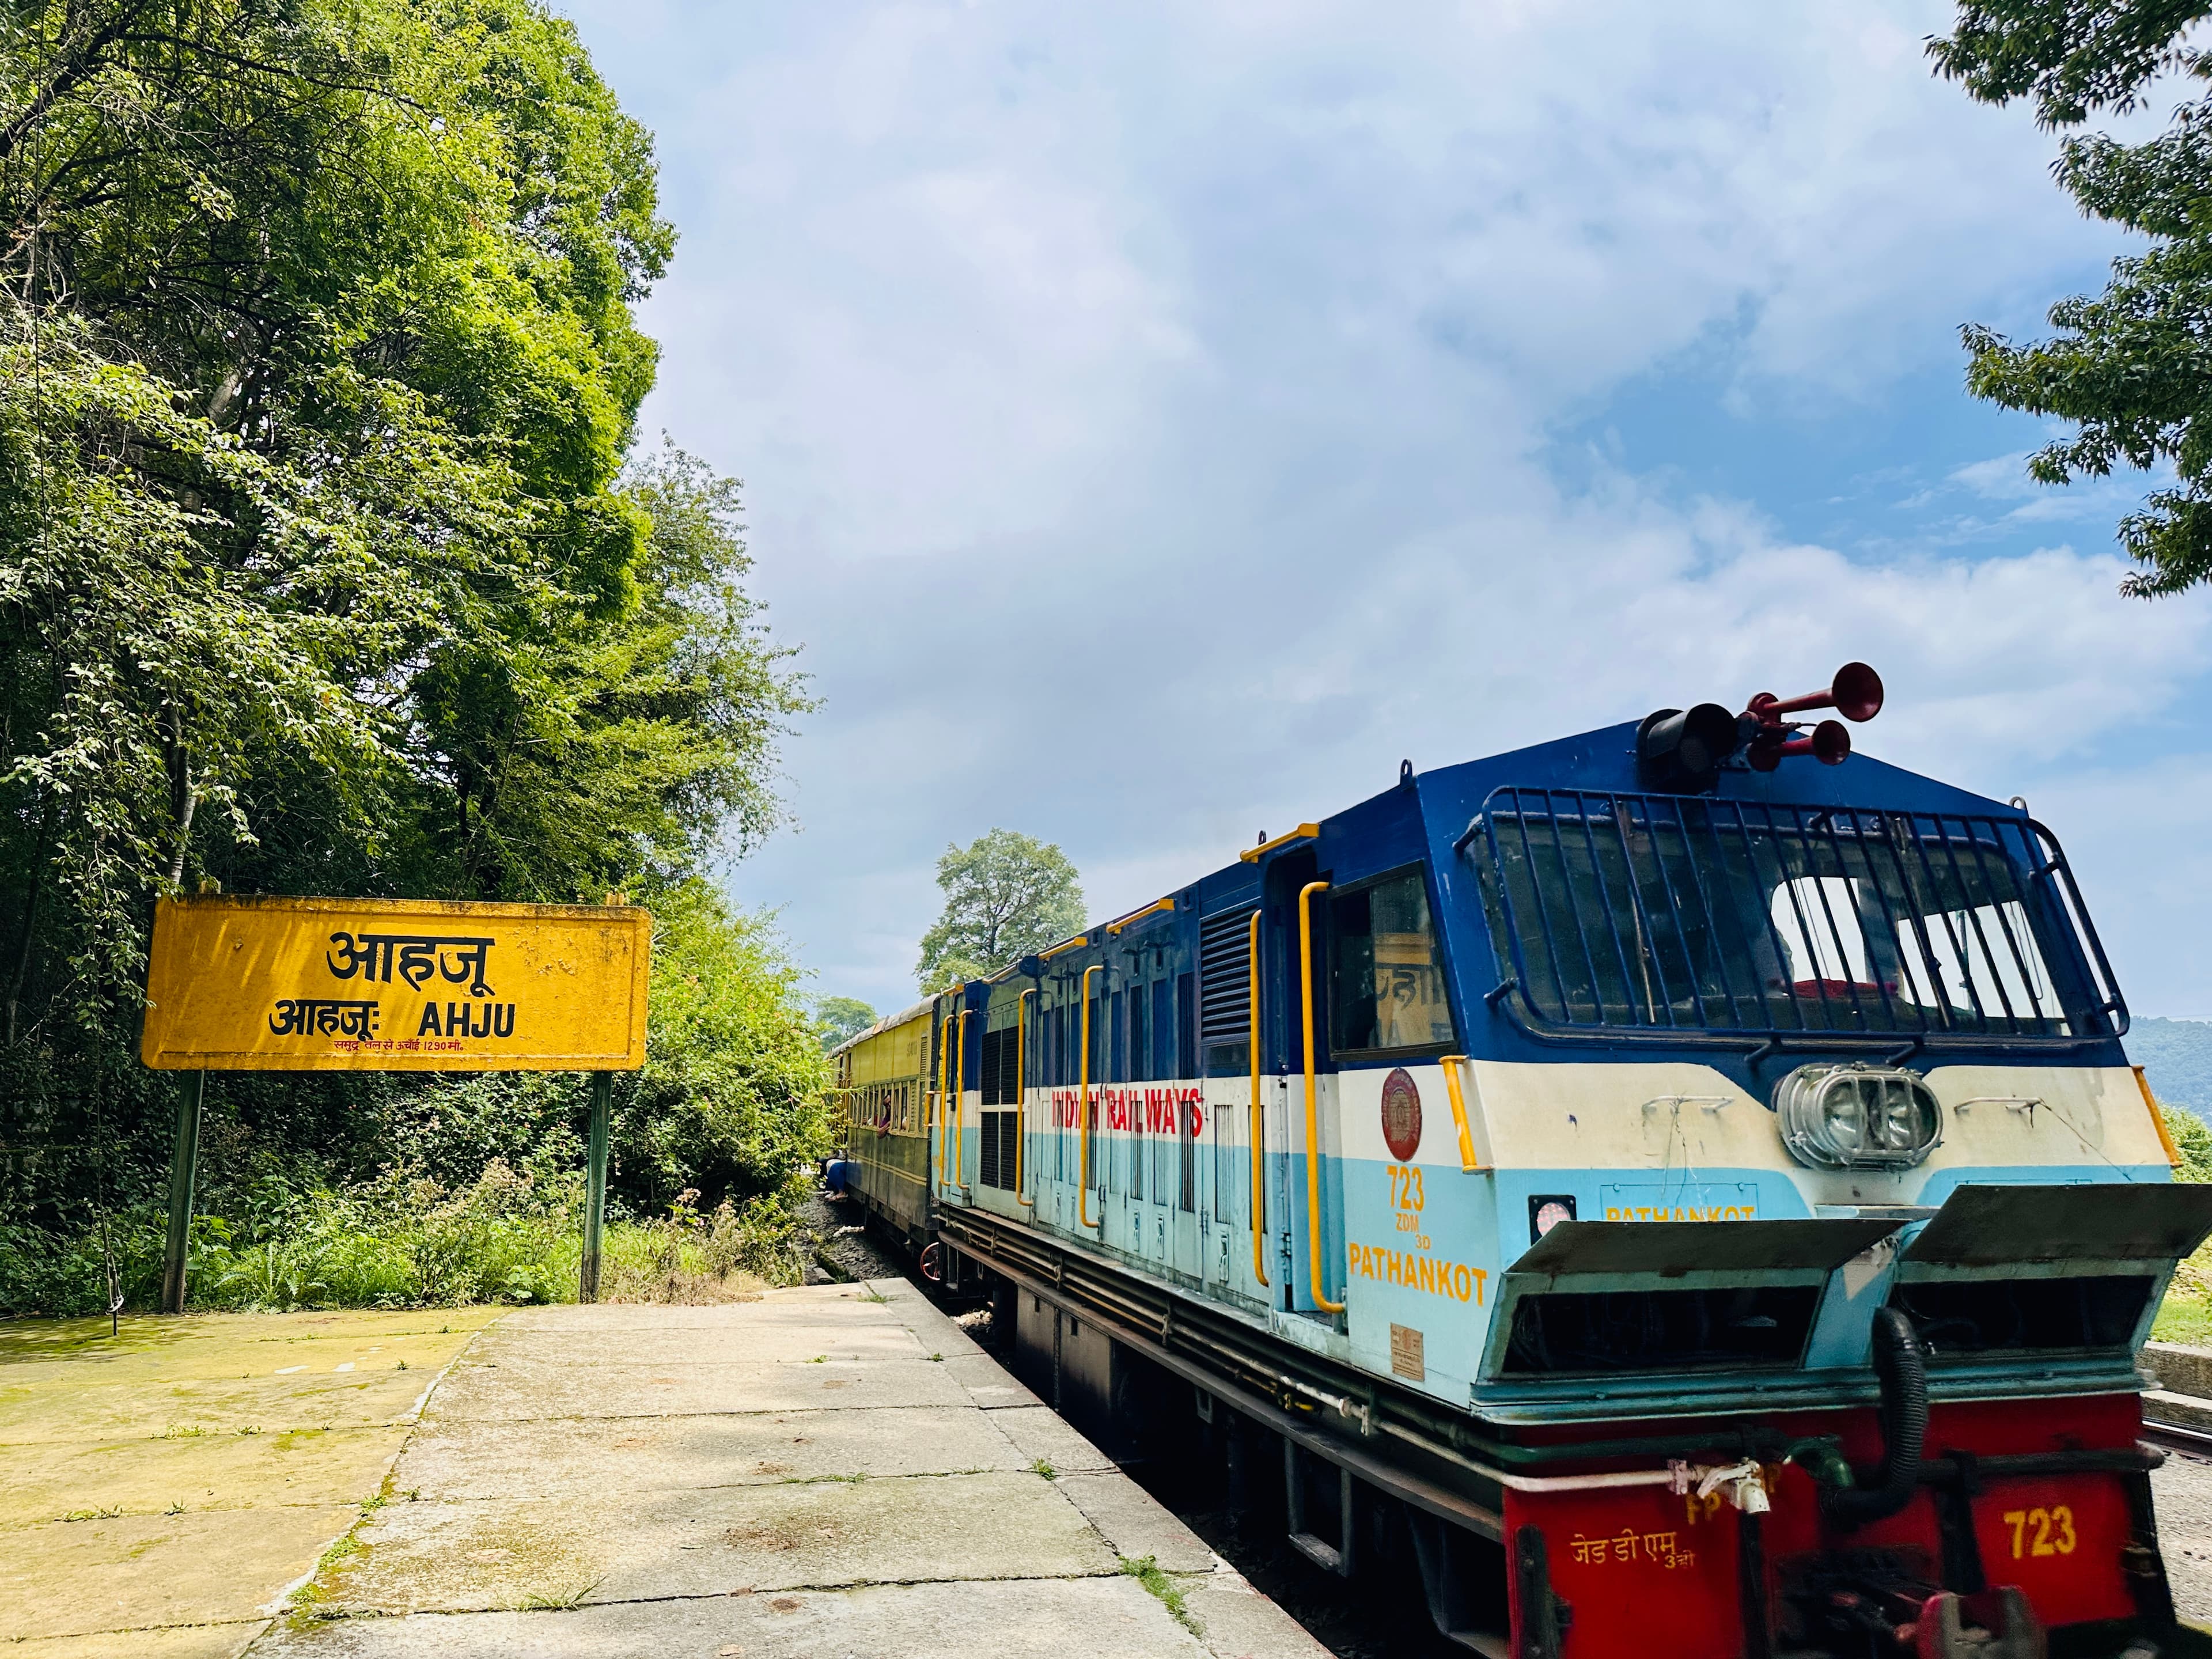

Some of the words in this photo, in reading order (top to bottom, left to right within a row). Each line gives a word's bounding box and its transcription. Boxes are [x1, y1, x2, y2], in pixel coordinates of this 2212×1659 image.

[326, 931, 495, 997] आहजू
[417, 1001, 516, 1037] AHJU
[334, 1040, 360, 1051] समुद्र
[365, 1041, 381, 1049] तल
[383, 1039, 393, 1050] से
[424, 1041, 446, 1050] 1290
[1105, 1088, 1203, 1138] RAILWAYS
[1387, 1165, 1425, 1212] 723
[1396, 1212, 1419, 1232] ZDM
[1349, 1242, 1488, 1307] PATHANKOT
[1570, 1533, 1609, 1564] जेड
[1612, 1528, 1639, 1561] डी
[1643, 1531, 1677, 1561] एम
[2003, 1505, 2077, 1559] 723
